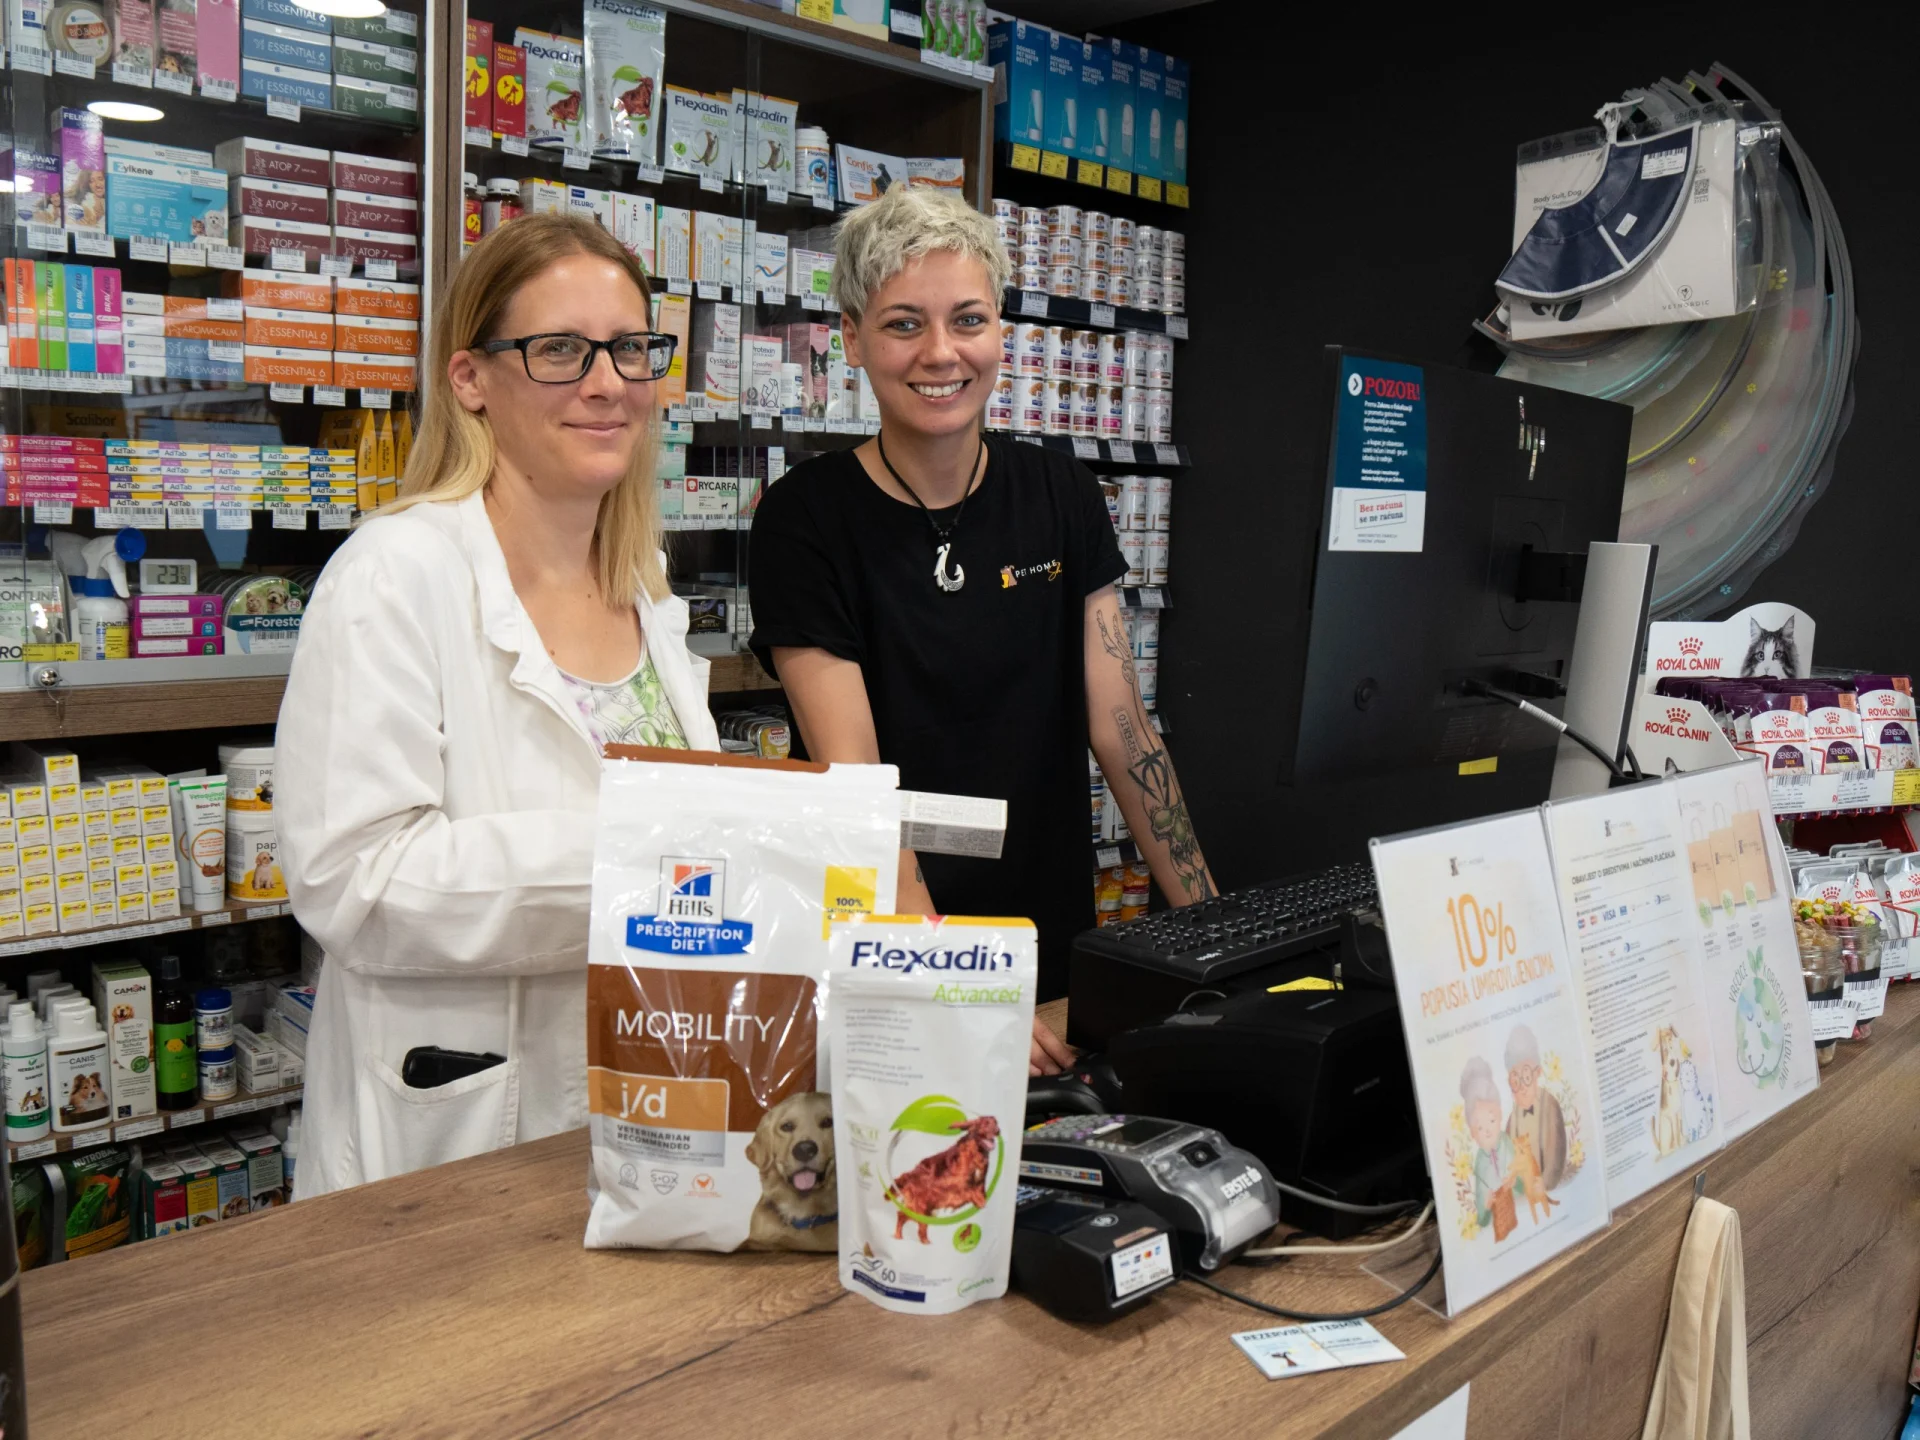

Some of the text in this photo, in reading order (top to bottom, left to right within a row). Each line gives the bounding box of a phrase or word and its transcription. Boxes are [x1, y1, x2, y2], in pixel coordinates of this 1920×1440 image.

[594, 0, 658, 19] Flexadin
[364, 22, 384, 34] PYO
[267, 42, 327, 62] ESSENTIAL 6
[497, 45, 517, 56] Anima
[497, 53, 517, 63] Strath
[522, 40, 583, 64] Flexadin
[363, 59, 382, 71] PYO
[267, 81, 326, 101] ESSENTIAL 6
[364, 98, 384, 110] PYO
[675, 96, 728, 116] Flexadin
[735, 103, 788, 124] Flexadin
[15, 151, 57, 165] FELIWAY
[846, 156, 873, 172] Confis
[114, 161, 154, 177] Zylkene
[269, 161, 301, 173] ATOP 7
[358, 173, 388, 185] ATOP 7
[1533, 189, 1583, 205] Body Suit, Dog
[265, 200, 298, 212] ATOP 7
[359, 210, 390, 223] ATOP 7
[269, 237, 301, 250] ATOP 7
[74, 272, 83, 310] BRAVECTO
[101, 274, 112, 312] BRAVECTO
[267, 288, 326, 303] ESSENTIAL 6
[1661, 299, 1710, 310] VETNORDIC
[182, 324, 239, 337] AROMACALM
[269, 326, 328, 341] ESSENTIAL 6
[358, 335, 412, 348] ESSENTIAL 6
[183, 363, 240, 376] AROMACALM
[268, 364, 326, 379] ESSENTIAL 6
[1364, 377, 1421, 400] POZOR!
[66, 412, 117, 427] Scalibor
[698, 480, 739, 491] RYCARFA
[1360, 501, 1404, 513] Bez računa
[1379, 511, 1404, 521] računa
[1015, 559, 1057, 578] PET HOME
[1656, 657, 1721, 671] ROYAL CANIN
[1868, 708, 1911, 717] ROYAL CANIN
[1645, 721, 1710, 743] ROYAL CANIN
[1762, 728, 1805, 739] ROYAL CANIN
[1814, 725, 1857, 736] ROYAL CANIN
[1884, 728, 1907, 736] SENSORY
[1116, 712, 1141, 765] IMPERIO
[1776, 750, 1801, 760] SENSORY
[1830, 747, 1854, 755] SENSORY
[668, 898, 714, 918] Hill's
[835, 897, 864, 908] 100%
[1602, 908, 1617, 922] VISA
[635, 922, 744, 941] PRESCRIPTION
[1446, 893, 1517, 973] 10%
[671, 938, 706, 952] DIET
[851, 941, 1013, 975] Flexadin
[1420, 980, 1469, 1019] POPUSTA
[1471, 951, 1556, 1001] UMIROVLJENICIMA
[1762, 962, 1789, 1016] KORISTITE
[932, 983, 1021, 1005] Advanced
[616, 1008, 776, 1043] MOBILITY
[69, 1054, 97, 1065] CANIS
[70, 1062, 97, 1071] SHAMPOO
[619, 1082, 667, 1119] j/d
[617, 1124, 691, 1143] VETERINARIAN
[617, 1132, 691, 1151] RECOMMENDED
[1219, 1175, 1253, 1200] ERSTE
[881, 1268, 896, 1284] 60
